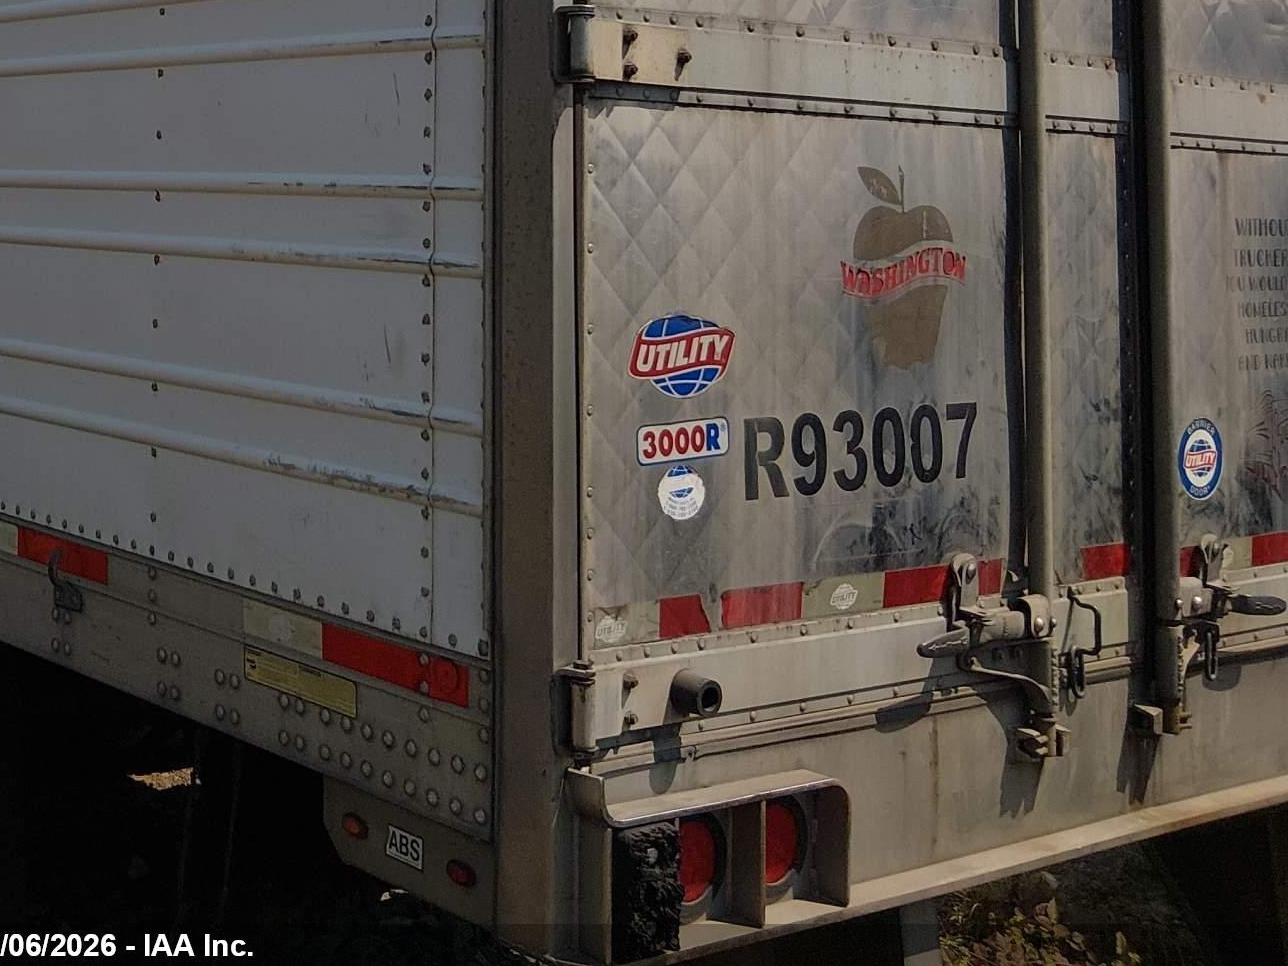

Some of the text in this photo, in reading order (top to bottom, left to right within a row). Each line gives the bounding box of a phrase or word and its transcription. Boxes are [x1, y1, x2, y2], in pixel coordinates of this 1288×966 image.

[840, 247, 966, 295] WASHINGTON
[636, 334, 730, 372] UTILITY
[743, 401, 978, 501] R93007
[1185, 451, 1217, 467] UTILITY
[388, 830, 420, 862] ABS
